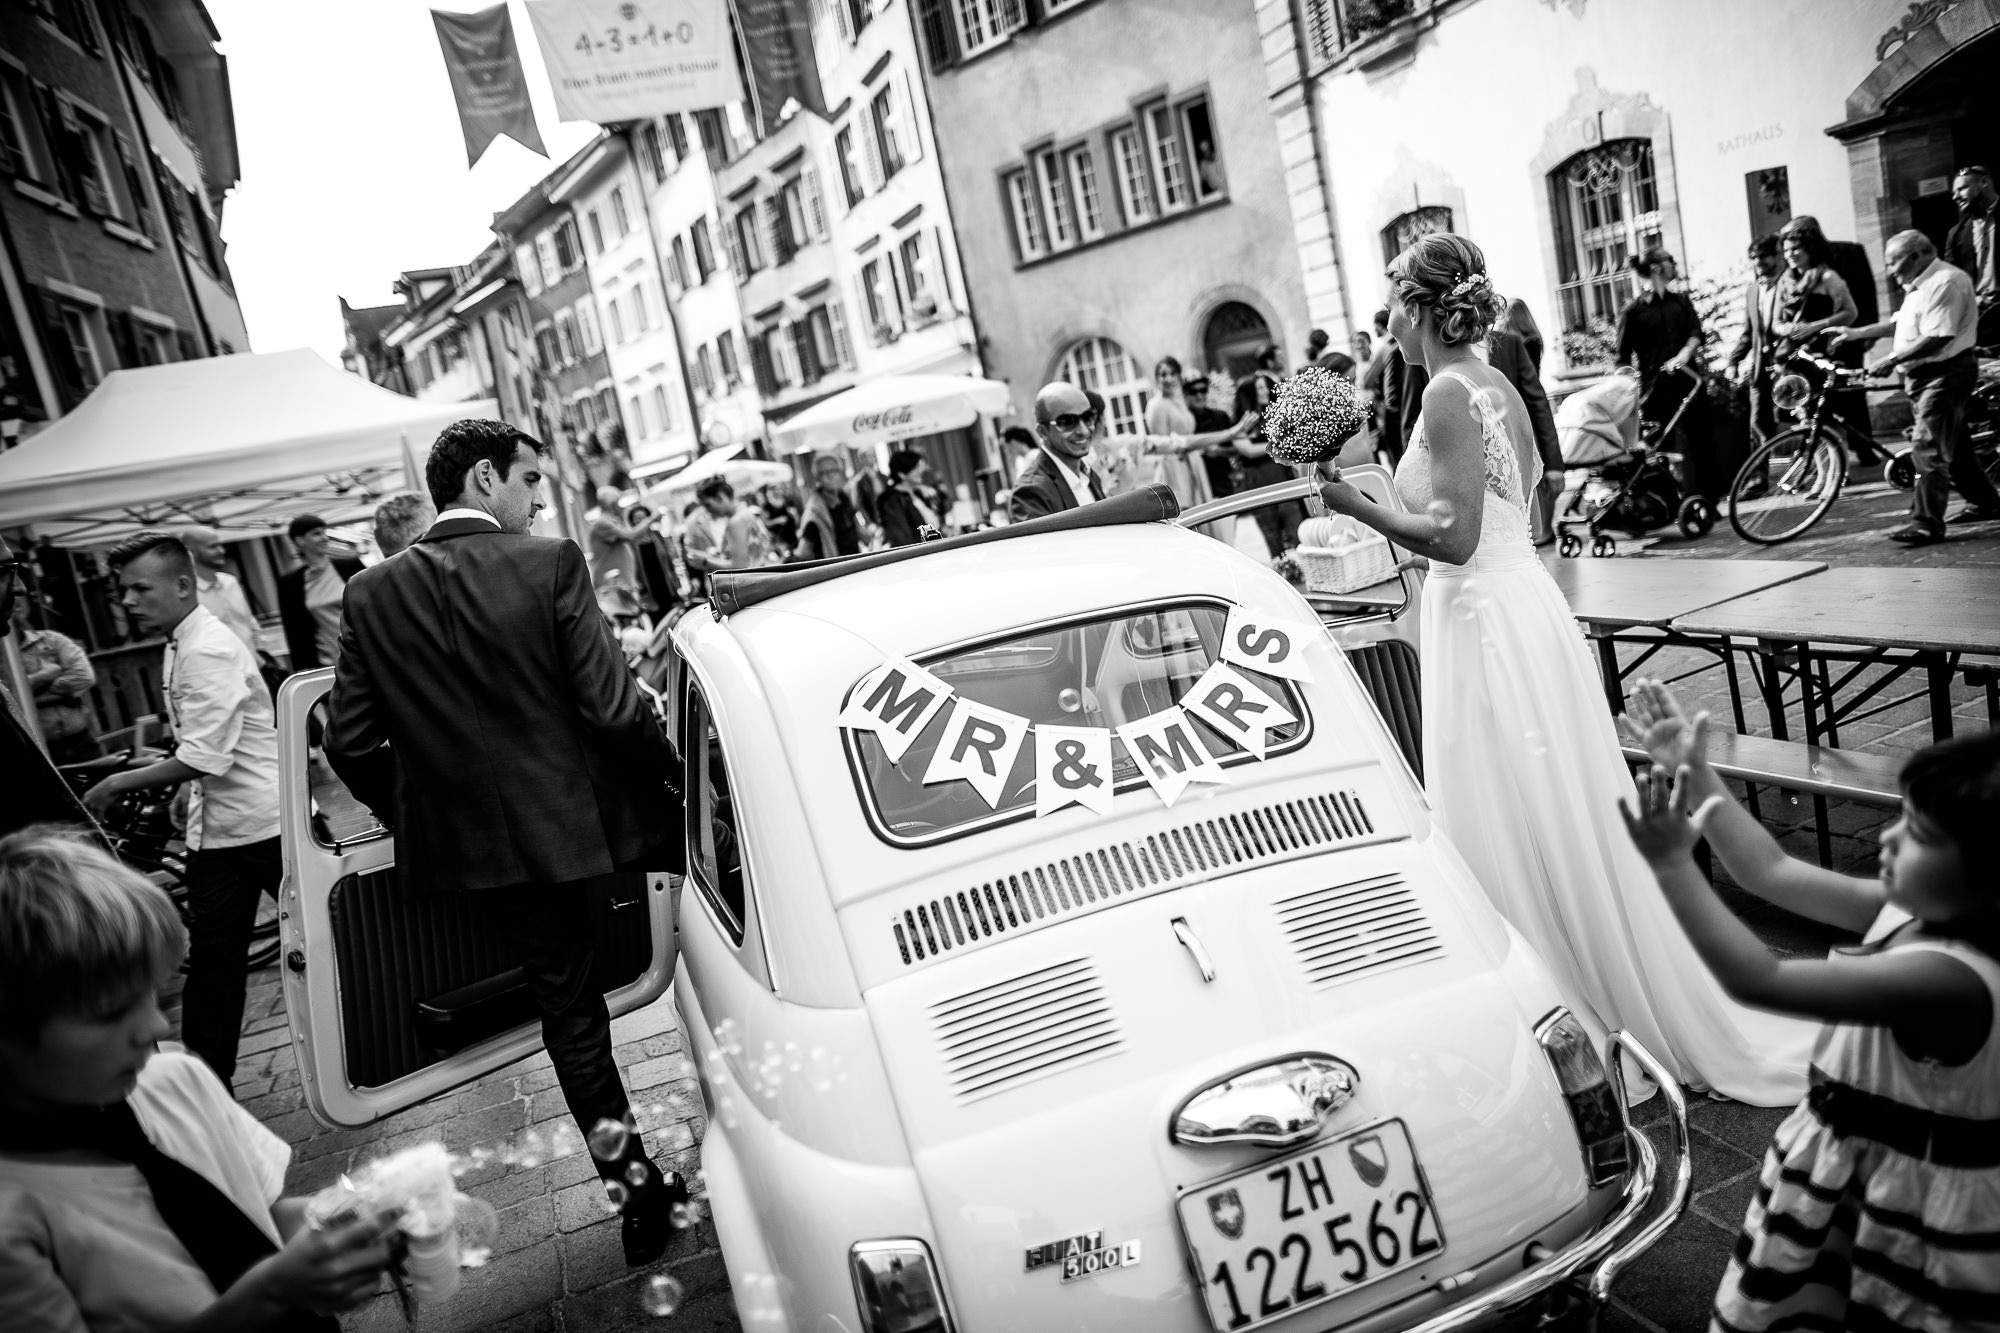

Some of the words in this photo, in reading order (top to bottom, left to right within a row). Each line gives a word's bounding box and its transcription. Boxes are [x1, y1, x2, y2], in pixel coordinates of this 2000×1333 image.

[1717, 121, 1784, 155] RATHAUS
[1052, 739, 1104, 788] &
[1268, 1156, 1334, 1221] ZH
[1030, 1231, 1100, 1267] FIAT
[1066, 1243, 1136, 1278] 500L
